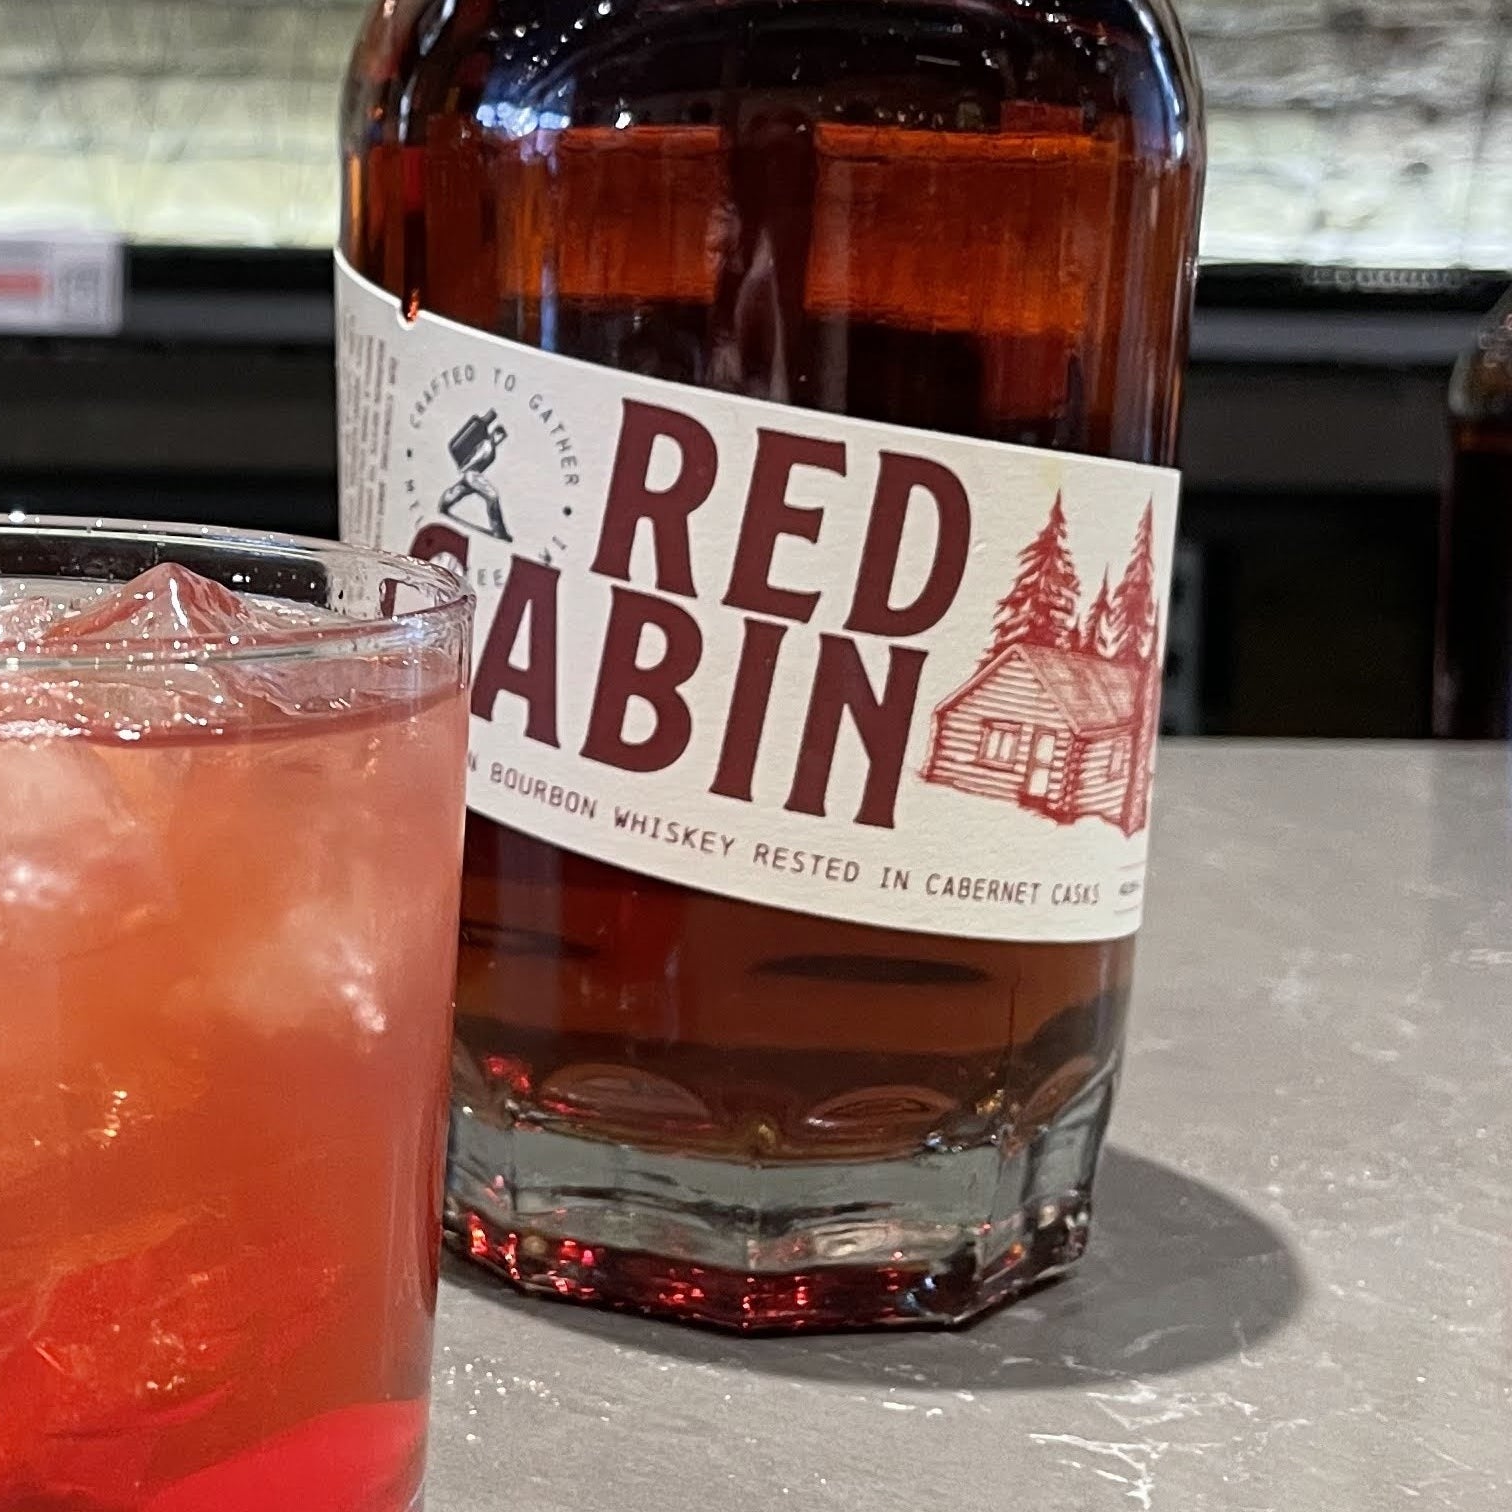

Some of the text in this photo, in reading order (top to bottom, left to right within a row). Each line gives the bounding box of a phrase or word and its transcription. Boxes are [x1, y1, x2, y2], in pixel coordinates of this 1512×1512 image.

[409, 364, 580, 487] CRAFTED TO GATHER
[590, 397, 972, 639] RED
[490, 761, 598, 819] BOURBON
[614, 806, 736, 857] WHISKEY
[752, 842, 861, 883] RESTED
[880, 867, 909, 890] IN
[925, 872, 1043, 905] CABERNET
[1051, 882, 1101, 905] CASKS
